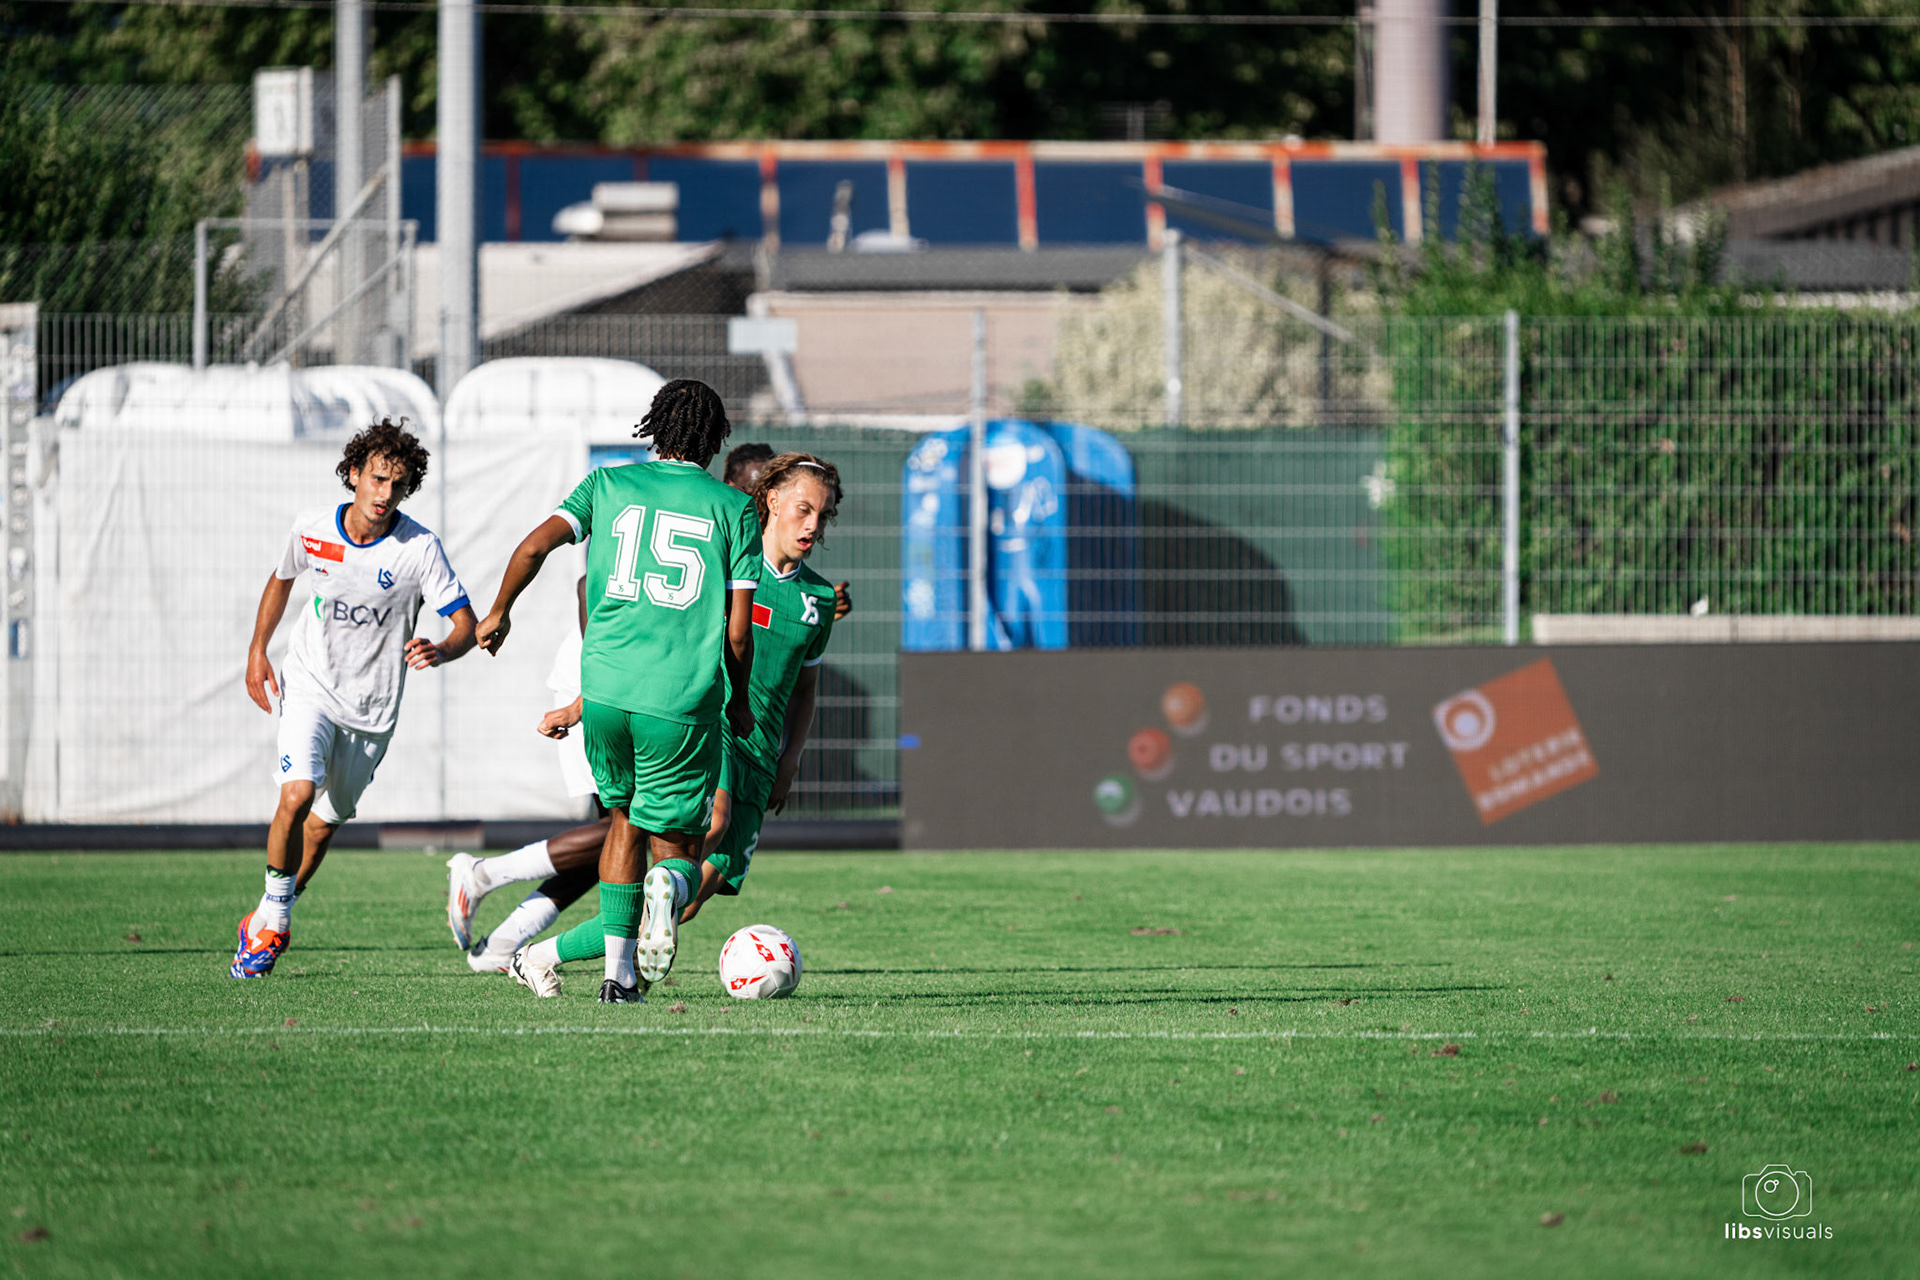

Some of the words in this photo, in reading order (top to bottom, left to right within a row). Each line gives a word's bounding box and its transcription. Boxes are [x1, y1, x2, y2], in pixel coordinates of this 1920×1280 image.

[605, 504, 715, 610] 15
[332, 600, 393, 627] BCV
[1249, 694, 1388, 724] FONDS
[1208, 743, 1269, 772] DU
[1281, 742, 1412, 771] SPORT
[1166, 788, 1352, 818] VAUDOIS
